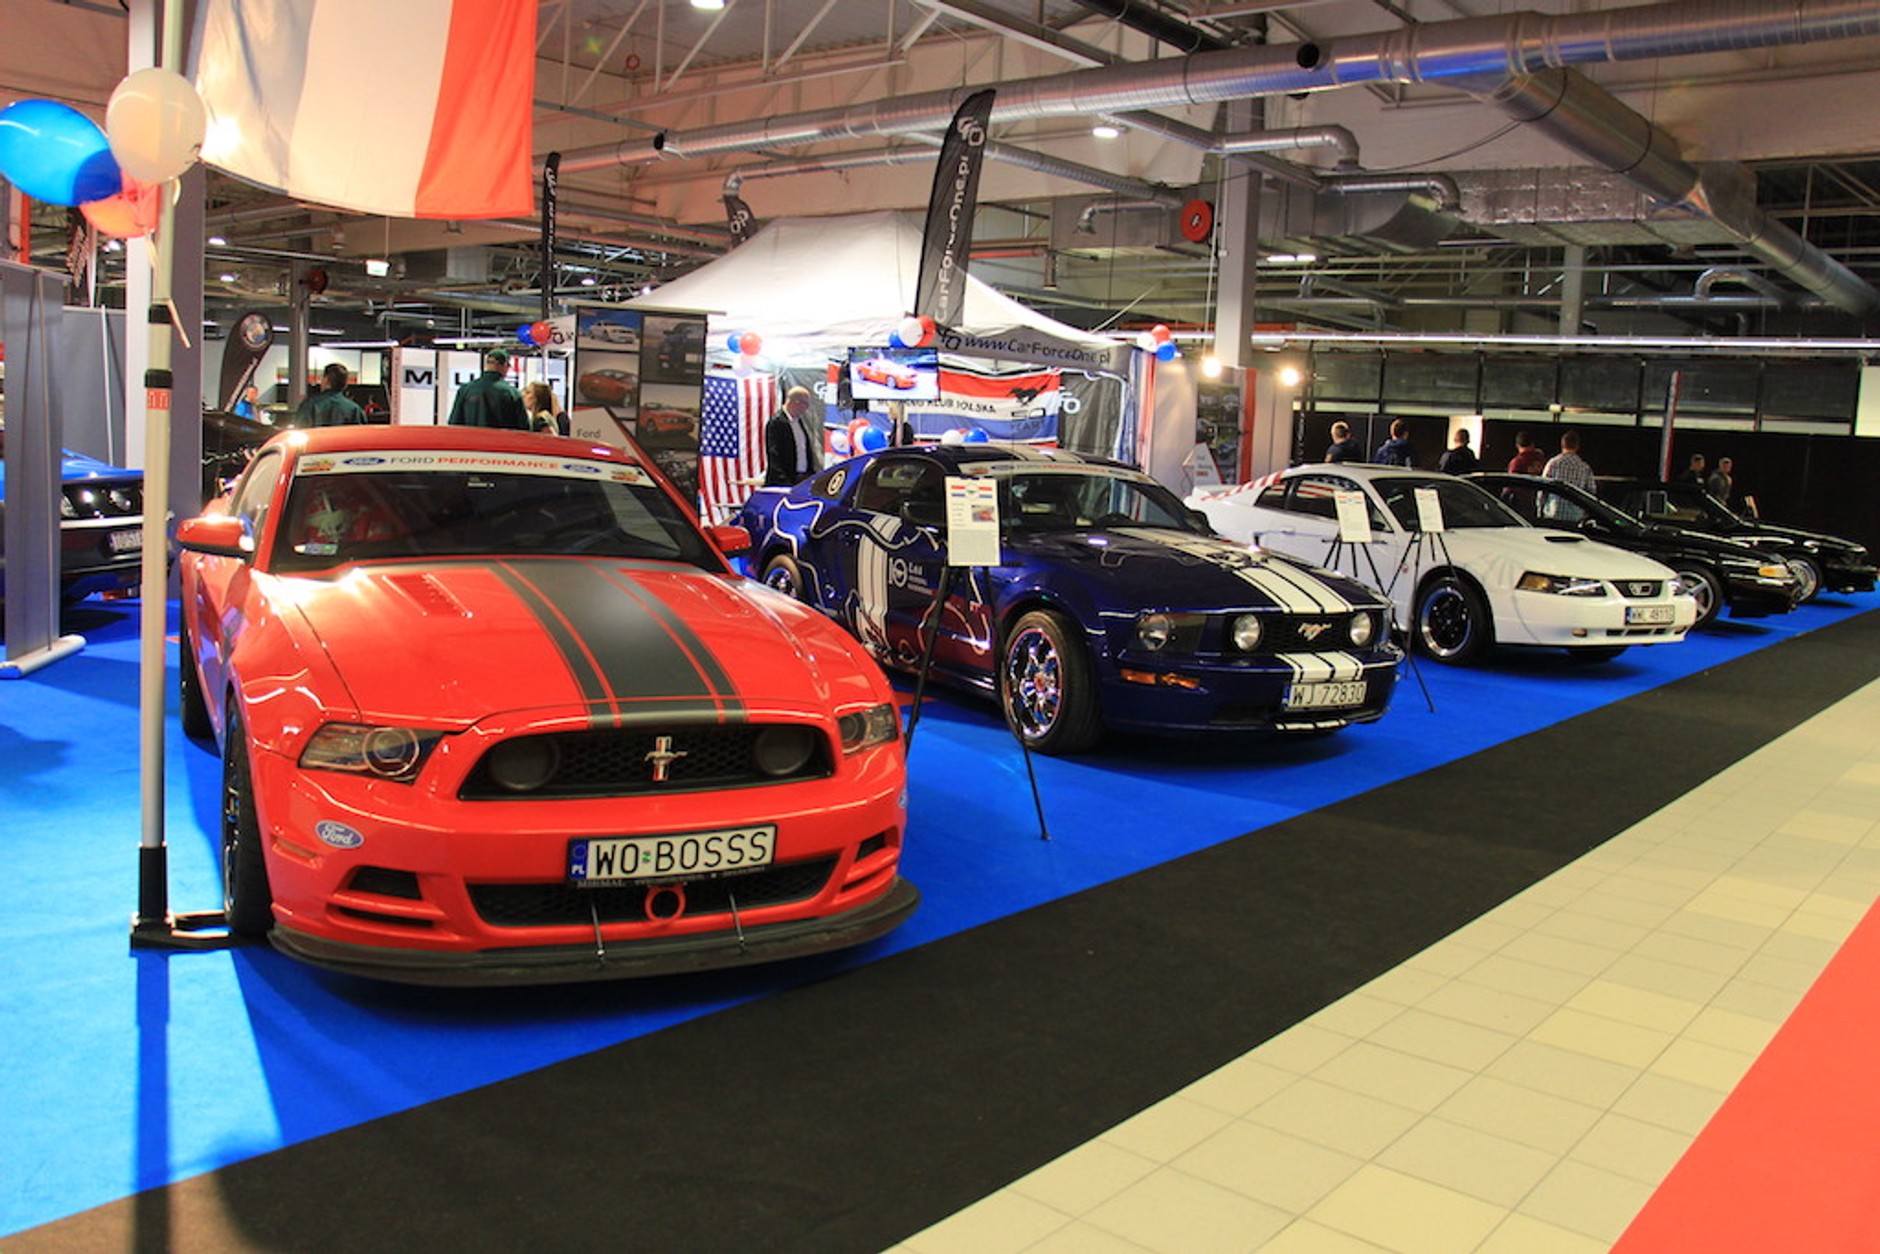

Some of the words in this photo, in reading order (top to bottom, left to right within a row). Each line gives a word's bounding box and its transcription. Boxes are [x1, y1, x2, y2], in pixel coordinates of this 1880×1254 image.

[576, 428, 602, 439] Ford
[390, 456, 435, 465] FORD
[436, 456, 560, 470] PERFORMANCE
[1292, 684, 1316, 705] WJ
[1320, 683, 1365, 704] 72830
[321, 822, 355, 845] Ford
[596, 843, 640, 876] WO
[655, 831, 768, 873] BOSSS
[571, 864, 586, 876] PL
